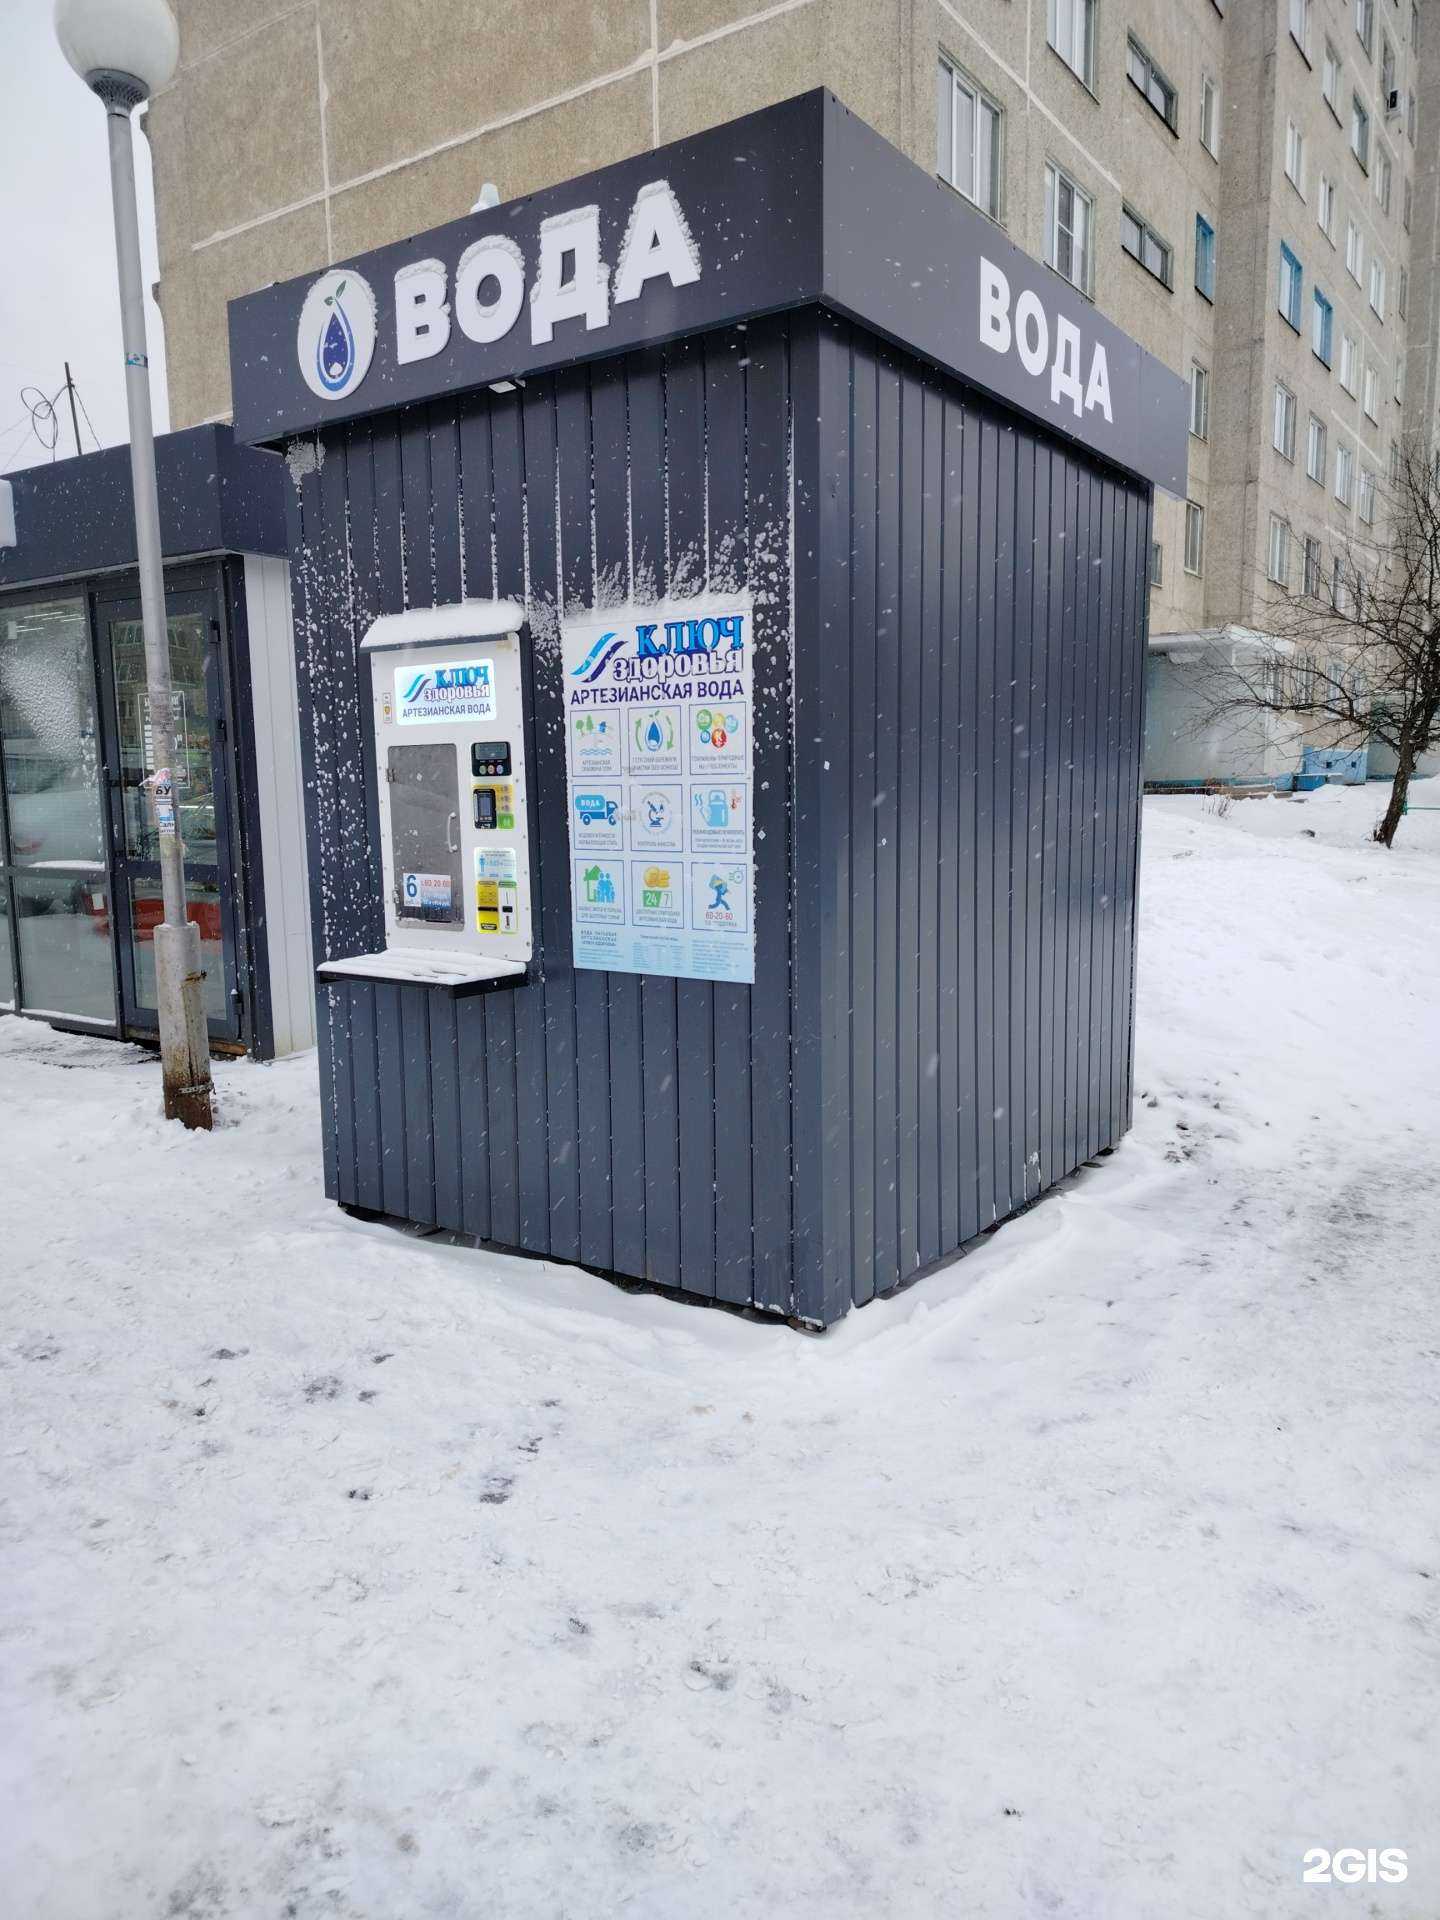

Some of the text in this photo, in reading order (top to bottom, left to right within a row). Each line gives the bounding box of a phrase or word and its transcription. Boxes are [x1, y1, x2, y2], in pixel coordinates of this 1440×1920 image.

[394, 179, 701, 365] ВОДА
[979, 255, 1113, 424] ВОДА
[635, 615, 744, 656] КЛЮЧ
[434, 666, 489, 688] КЛЮЧ
[570, 679, 744, 705] АРТЕЗИАНСКАЯ ВОДА
[402, 703, 491, 718] АРТЕЗИАНСКАЯ ВОДА
[580, 799, 600, 809] ВОДА
[406, 874, 417, 898] 6
